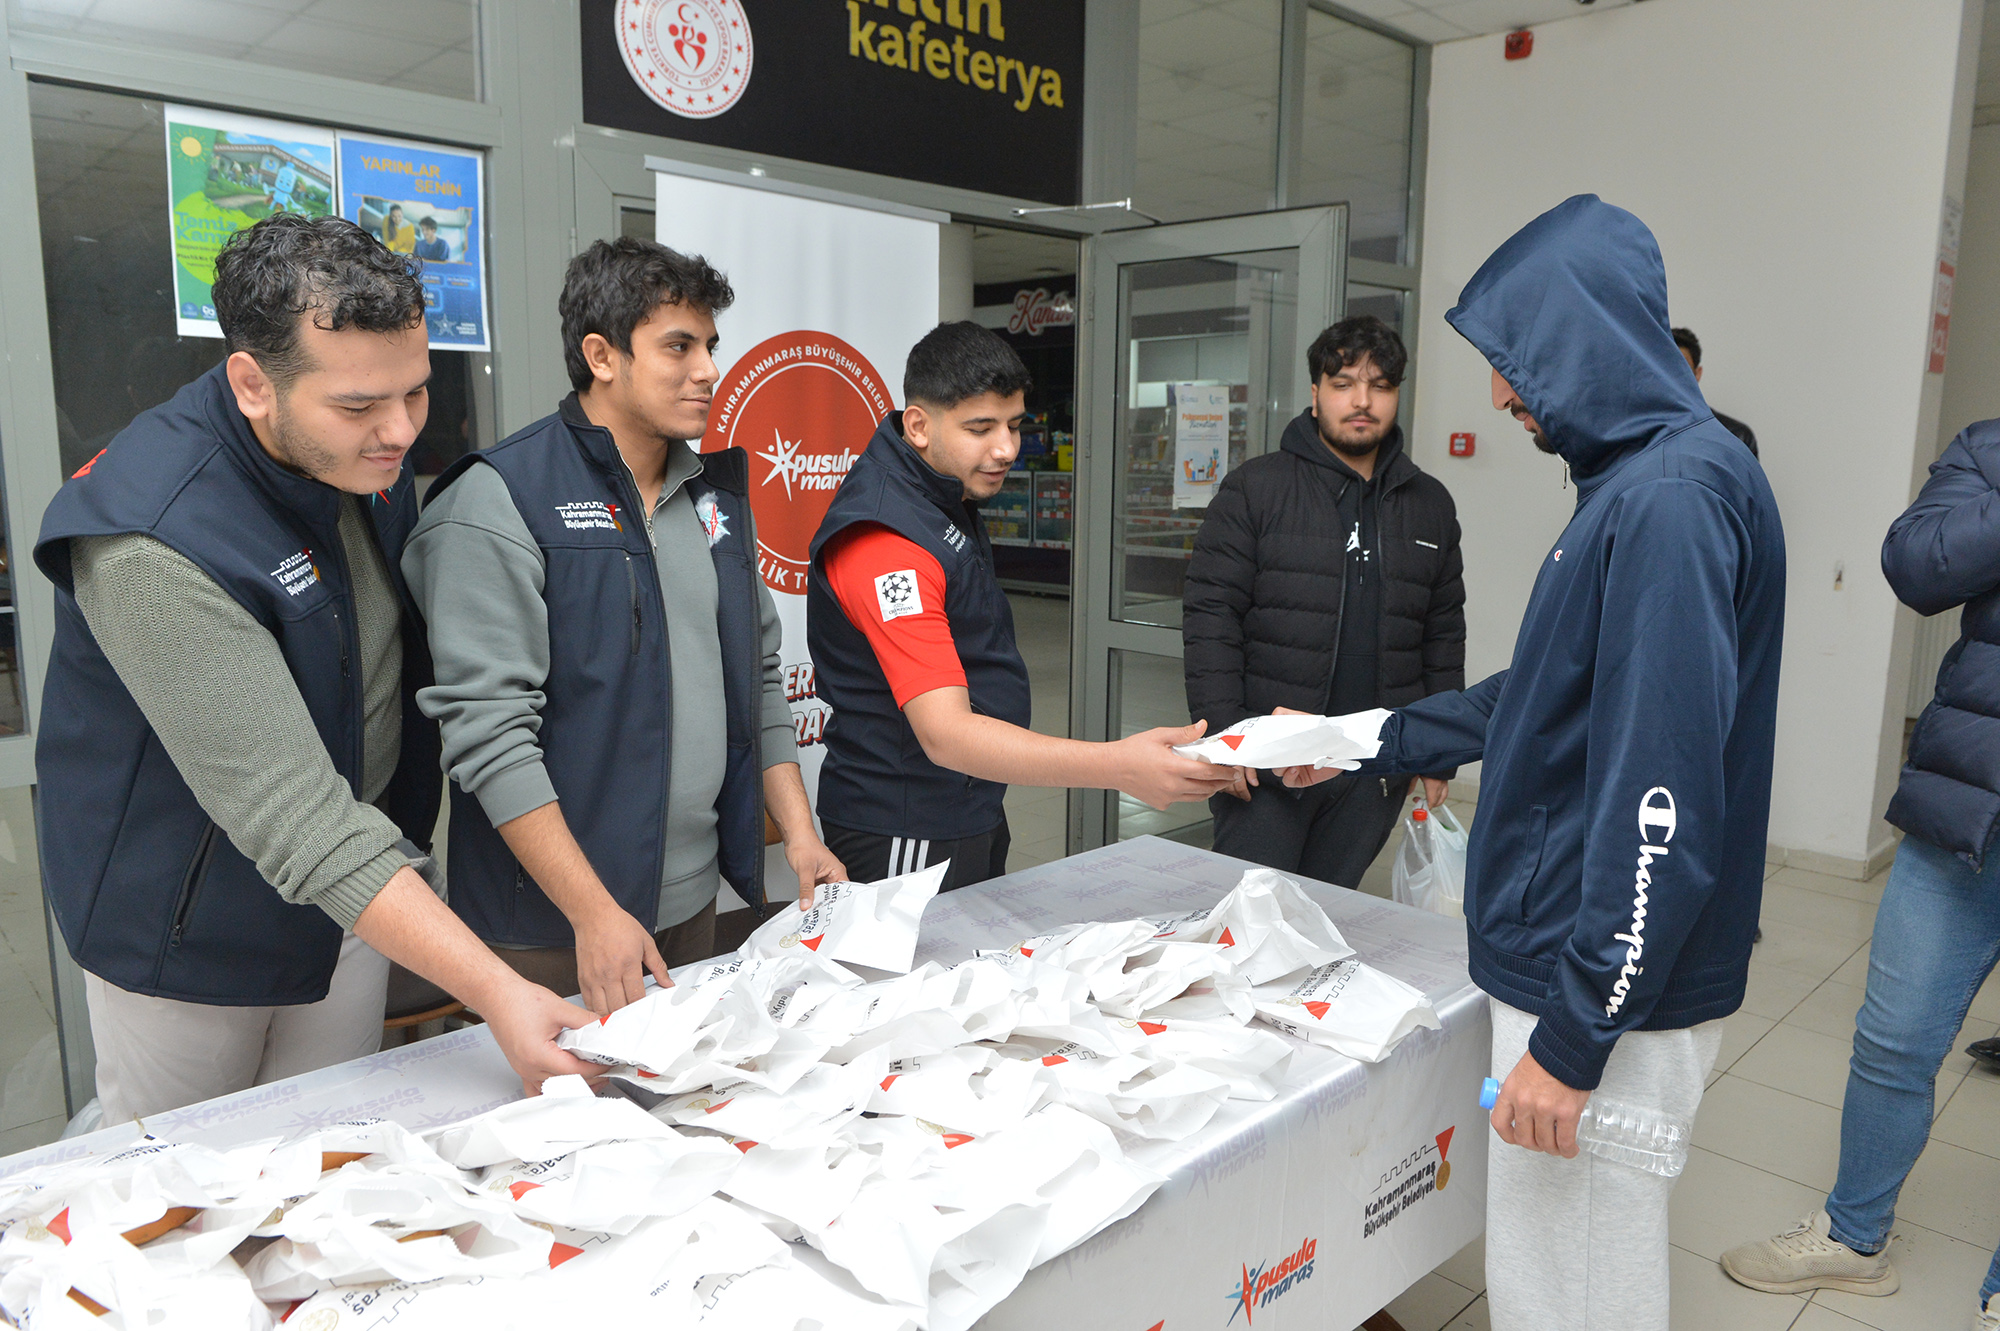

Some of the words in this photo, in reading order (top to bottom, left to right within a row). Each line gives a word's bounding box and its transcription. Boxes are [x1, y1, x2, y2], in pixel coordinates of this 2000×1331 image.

[846, 2, 1064, 112] kafeterya
[360, 154, 441, 180] YARINLAR
[414, 178, 462, 197] SENİN
[716, 346, 802, 433] KAHRAMANMARAŞ
[800, 473, 846, 491] mar
[1605, 786, 1677, 1018] Champion
[1363, 1202, 1401, 1239] Büyükşehir
[1401, 1175, 1436, 1212] Belediyesi
[1364, 1160, 1436, 1221] Kahramanmaraş
[1252, 1236, 1318, 1307] pusula
[1260, 1258, 1315, 1309] maraş
